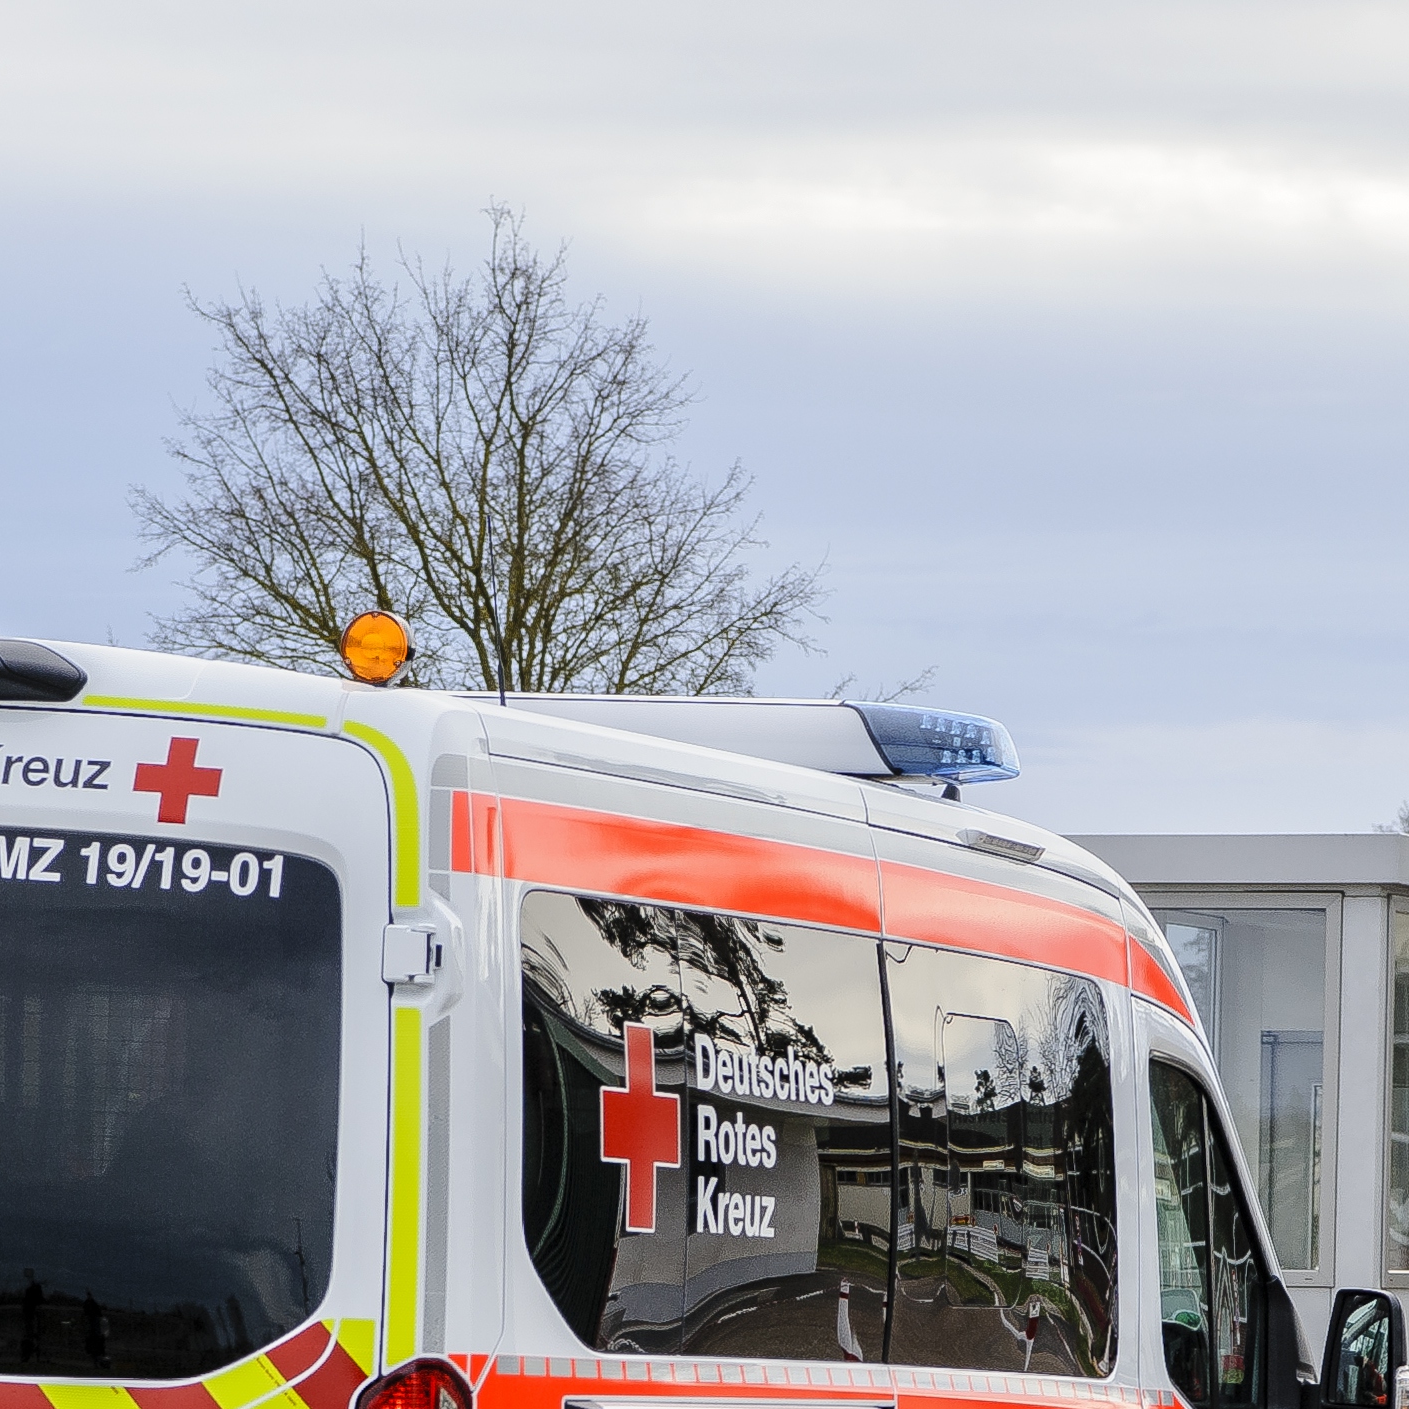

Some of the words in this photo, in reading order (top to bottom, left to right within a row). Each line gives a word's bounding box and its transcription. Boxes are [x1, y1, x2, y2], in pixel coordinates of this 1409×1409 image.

[79, 843, 285, 898] 19/19-01
[695, 1033, 834, 1105] Deutsches
[697, 1104, 777, 1169] Rotes
[696, 1175, 776, 1238] Kreuz
